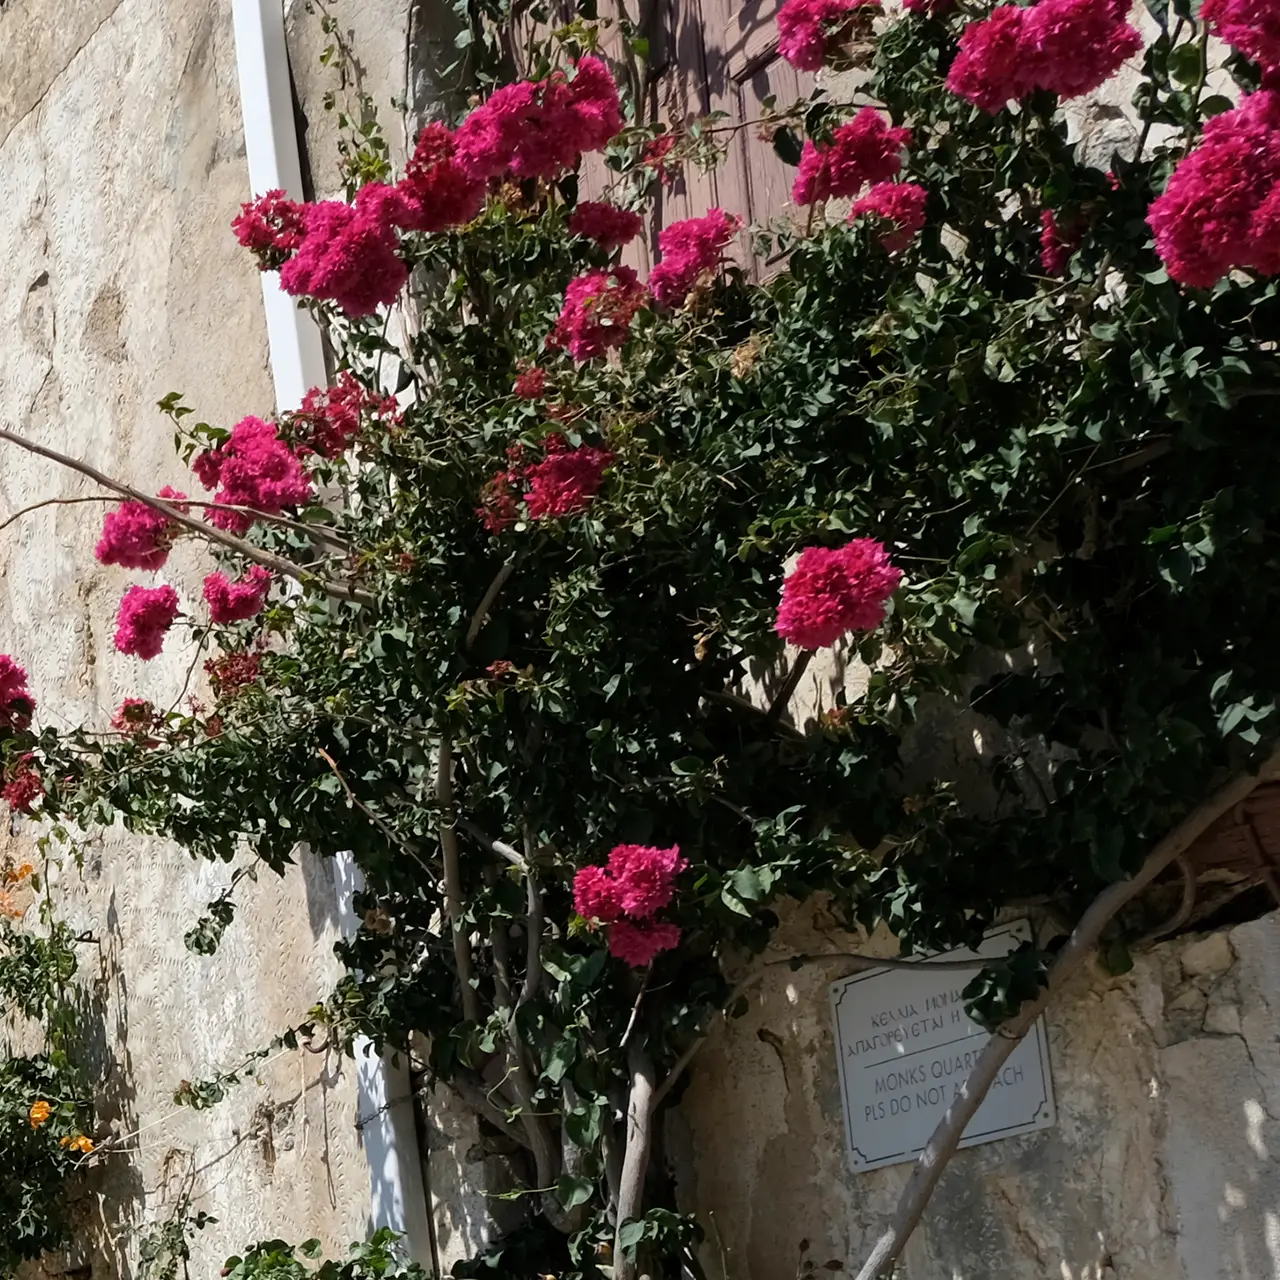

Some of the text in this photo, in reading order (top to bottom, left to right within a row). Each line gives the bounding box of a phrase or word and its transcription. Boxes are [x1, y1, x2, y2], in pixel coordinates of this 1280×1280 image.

[874, 1047, 986, 1095] MONKS QUART
[864, 1101, 886, 1123] PLS
[890, 1095, 912, 1116] DO
[916, 1085, 947, 1109] NOT
